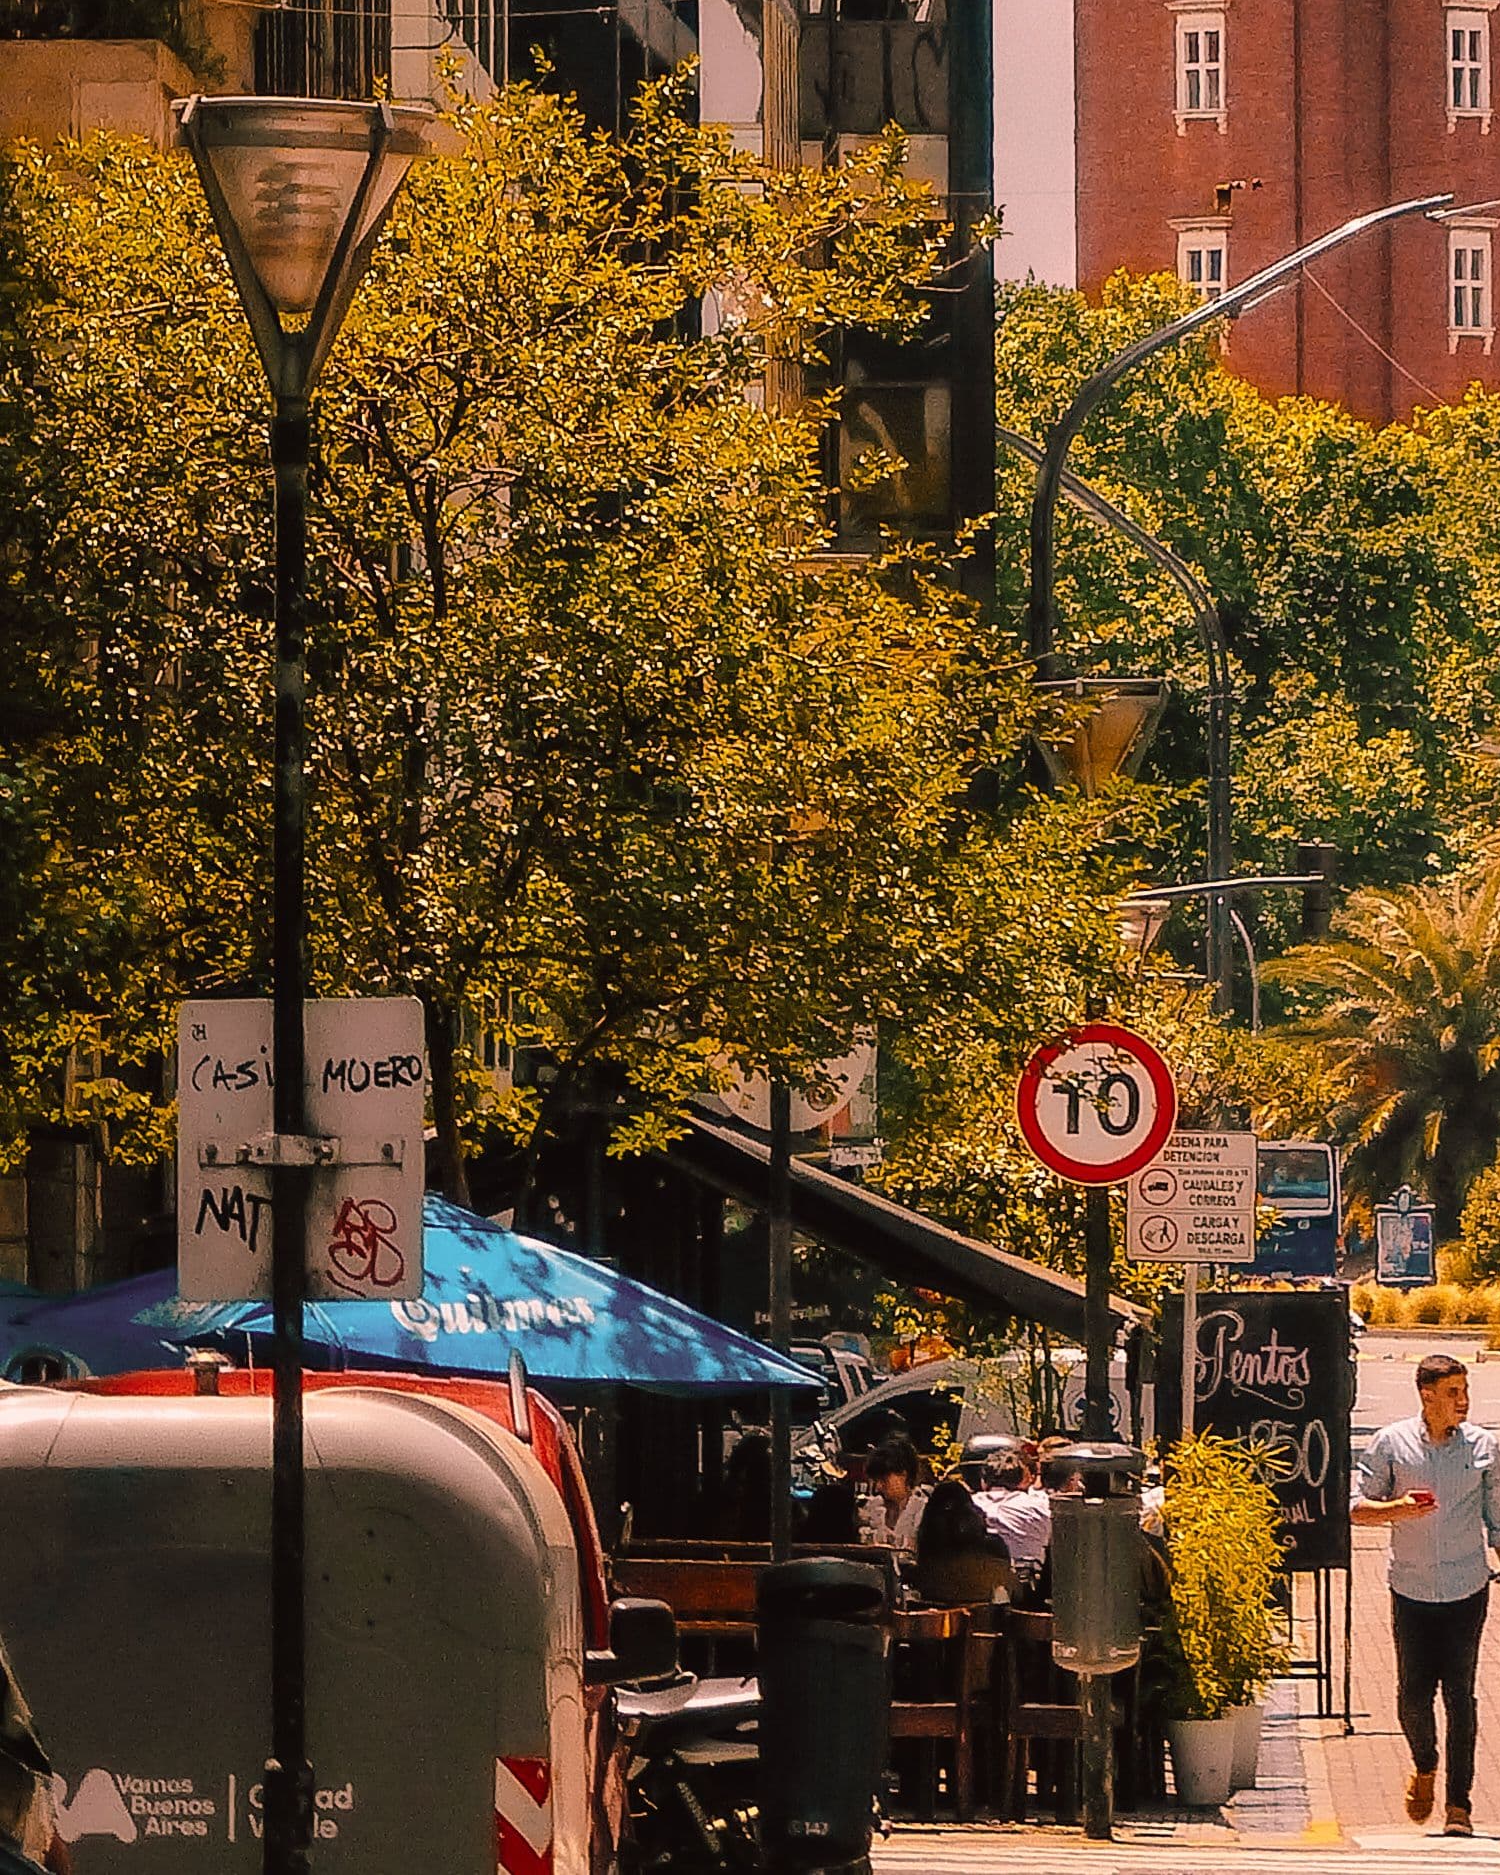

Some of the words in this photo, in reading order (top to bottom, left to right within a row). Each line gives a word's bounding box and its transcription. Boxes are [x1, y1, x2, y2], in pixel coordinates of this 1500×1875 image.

[322, 1054, 423, 1094] MUERO
[1052, 1072, 1140, 1136] 10
[1236, 1180, 1244, 1193] Y
[1193, 1216, 1230, 1229] CARGA
[1232, 1217, 1239, 1228] Y
[1187, 1232, 1246, 1245] DESCARGA
[115, 1774, 193, 1795] Vamos
[131, 1795, 215, 1817] Buenos
[145, 1816, 208, 1837] Aires
